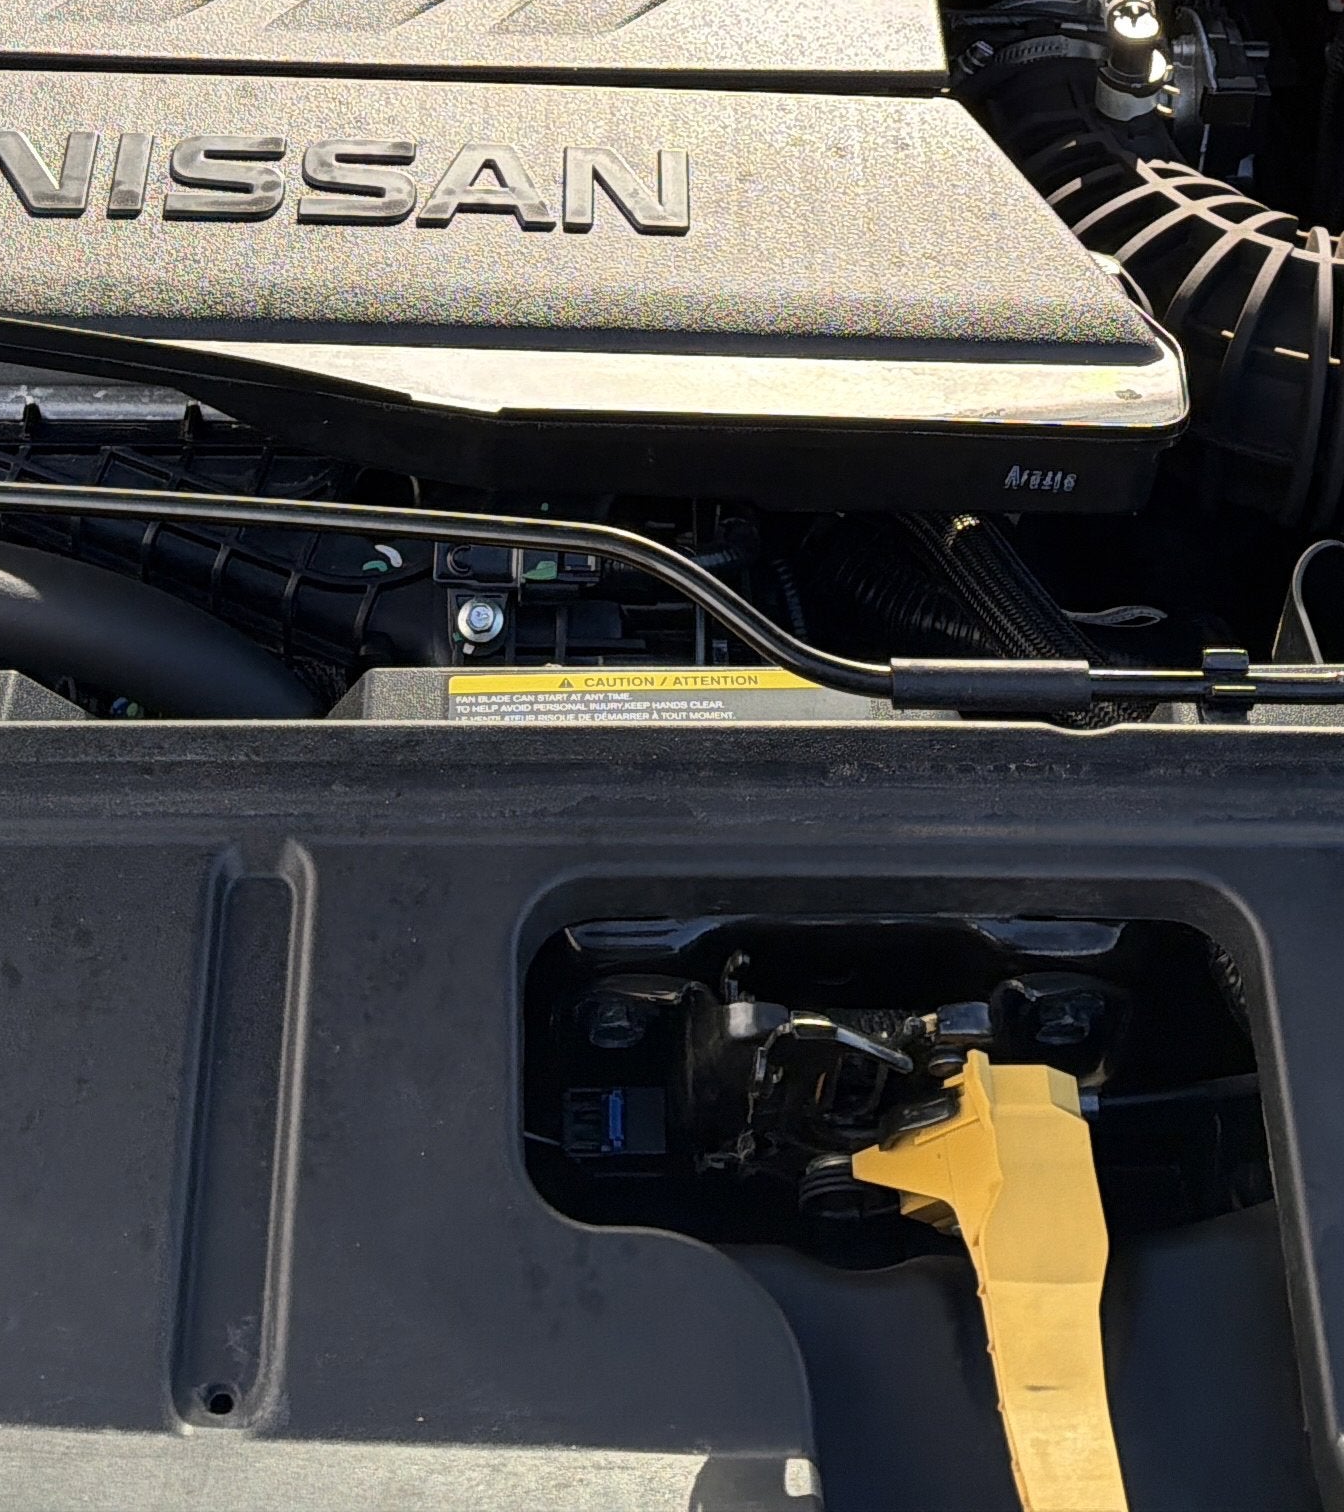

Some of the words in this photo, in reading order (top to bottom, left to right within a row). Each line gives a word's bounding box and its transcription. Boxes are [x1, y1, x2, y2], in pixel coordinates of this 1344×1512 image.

[584, 676, 655, 687] CAUTION
[660, 676, 668, 687] /
[673, 674, 759, 686] ATTENTION
[456, 695, 475, 704] FAN
[478, 694, 511, 703] BLADE
[513, 694, 535, 703] CAN
[537, 693, 568, 702] START
[570, 693, 582, 701] AT
[584, 692, 605, 701] ANY
[607, 692, 633, 701] TIME.
[456, 705, 470, 713] TO
[472, 704, 498, 713] HELP
[500, 704, 531, 712] AVOID
[533, 703, 587, 711] PERSONAL
[652, 701, 688, 710] HANDS
[689, 700, 725, 709] CLEAR.
[578, 713, 592, 721] DE
[594, 711, 649, 721] DÉMARRER
[651, 710, 659, 720] À
[661, 711, 688, 720] TOUT
[689, 711, 736, 720] MOMENT.
